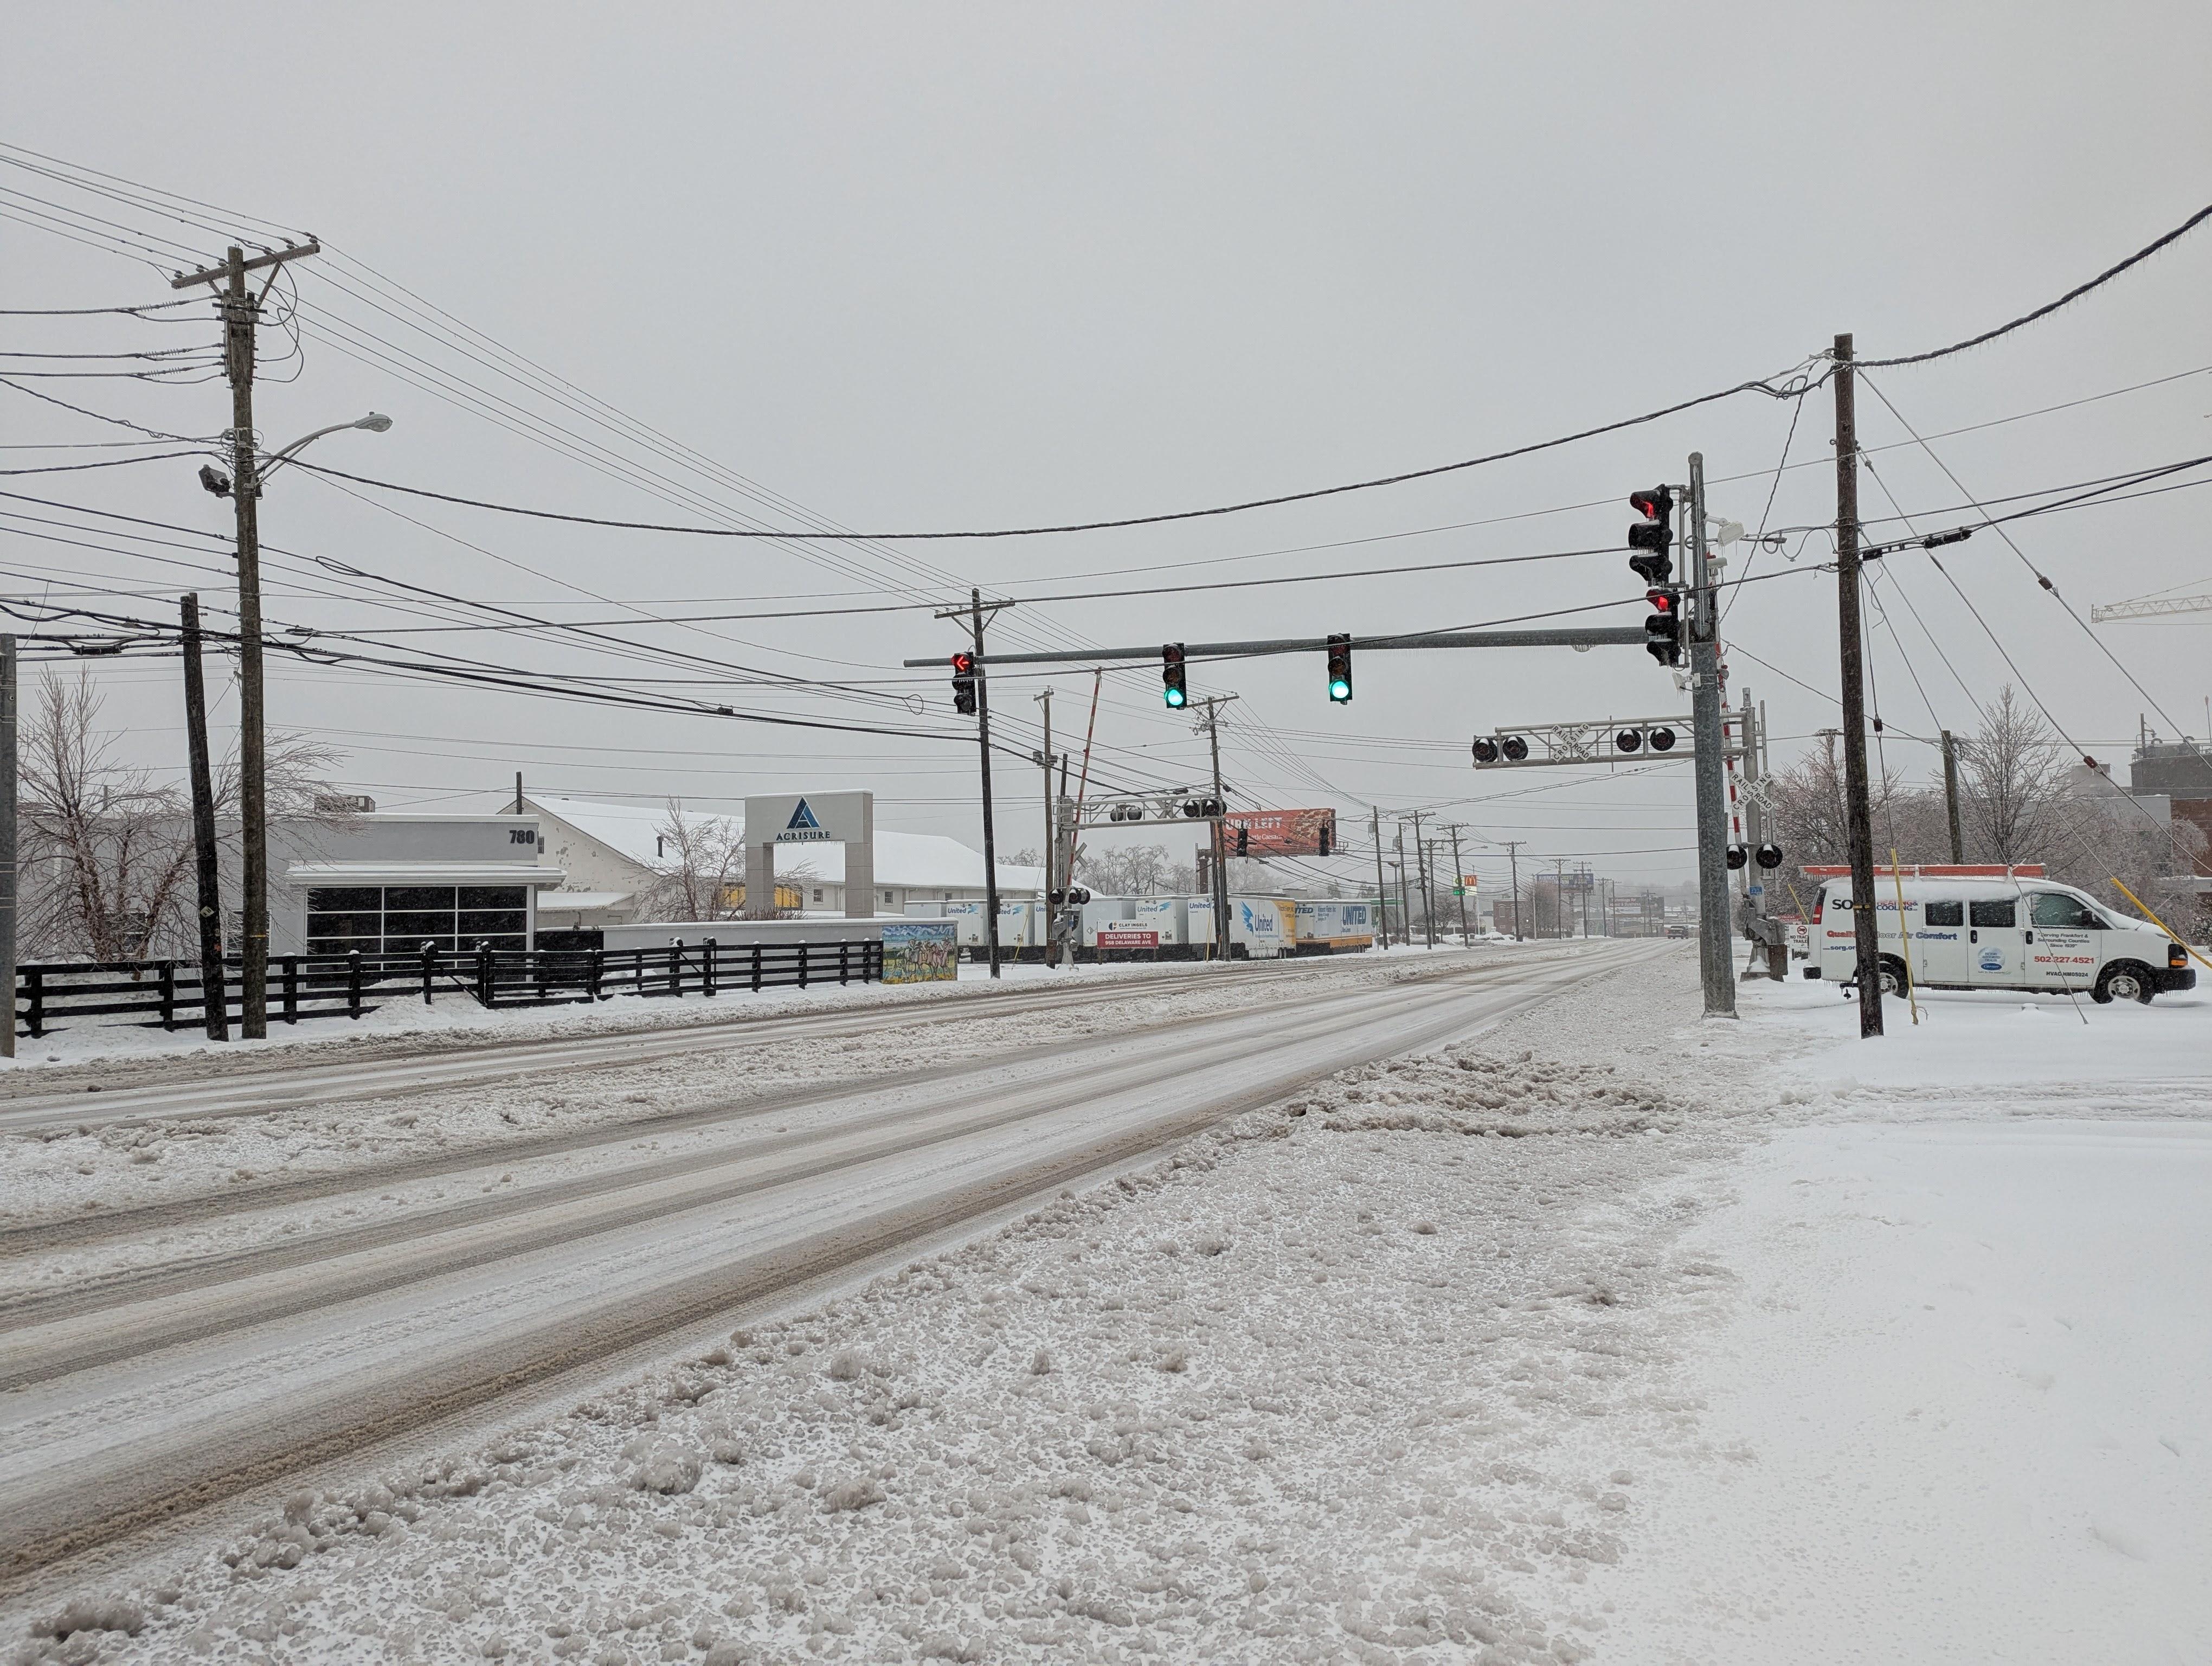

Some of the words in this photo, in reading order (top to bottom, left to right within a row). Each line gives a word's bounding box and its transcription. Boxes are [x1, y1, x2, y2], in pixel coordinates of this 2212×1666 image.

[1553, 724, 1589, 760] CROSSING
[1733, 773, 1771, 810] CROSSING
[1226, 818, 1252, 830] URN
[1255, 817, 1282, 830] LEFT
[509, 830, 535, 844] 780
[776, 831, 831, 841] ACRISURE
[1832, 899, 1854, 910] SO
[1255, 914, 1273, 932] United
[1342, 906, 1367, 926] UNITED
[1915, 932, 1957, 940] Comfort
